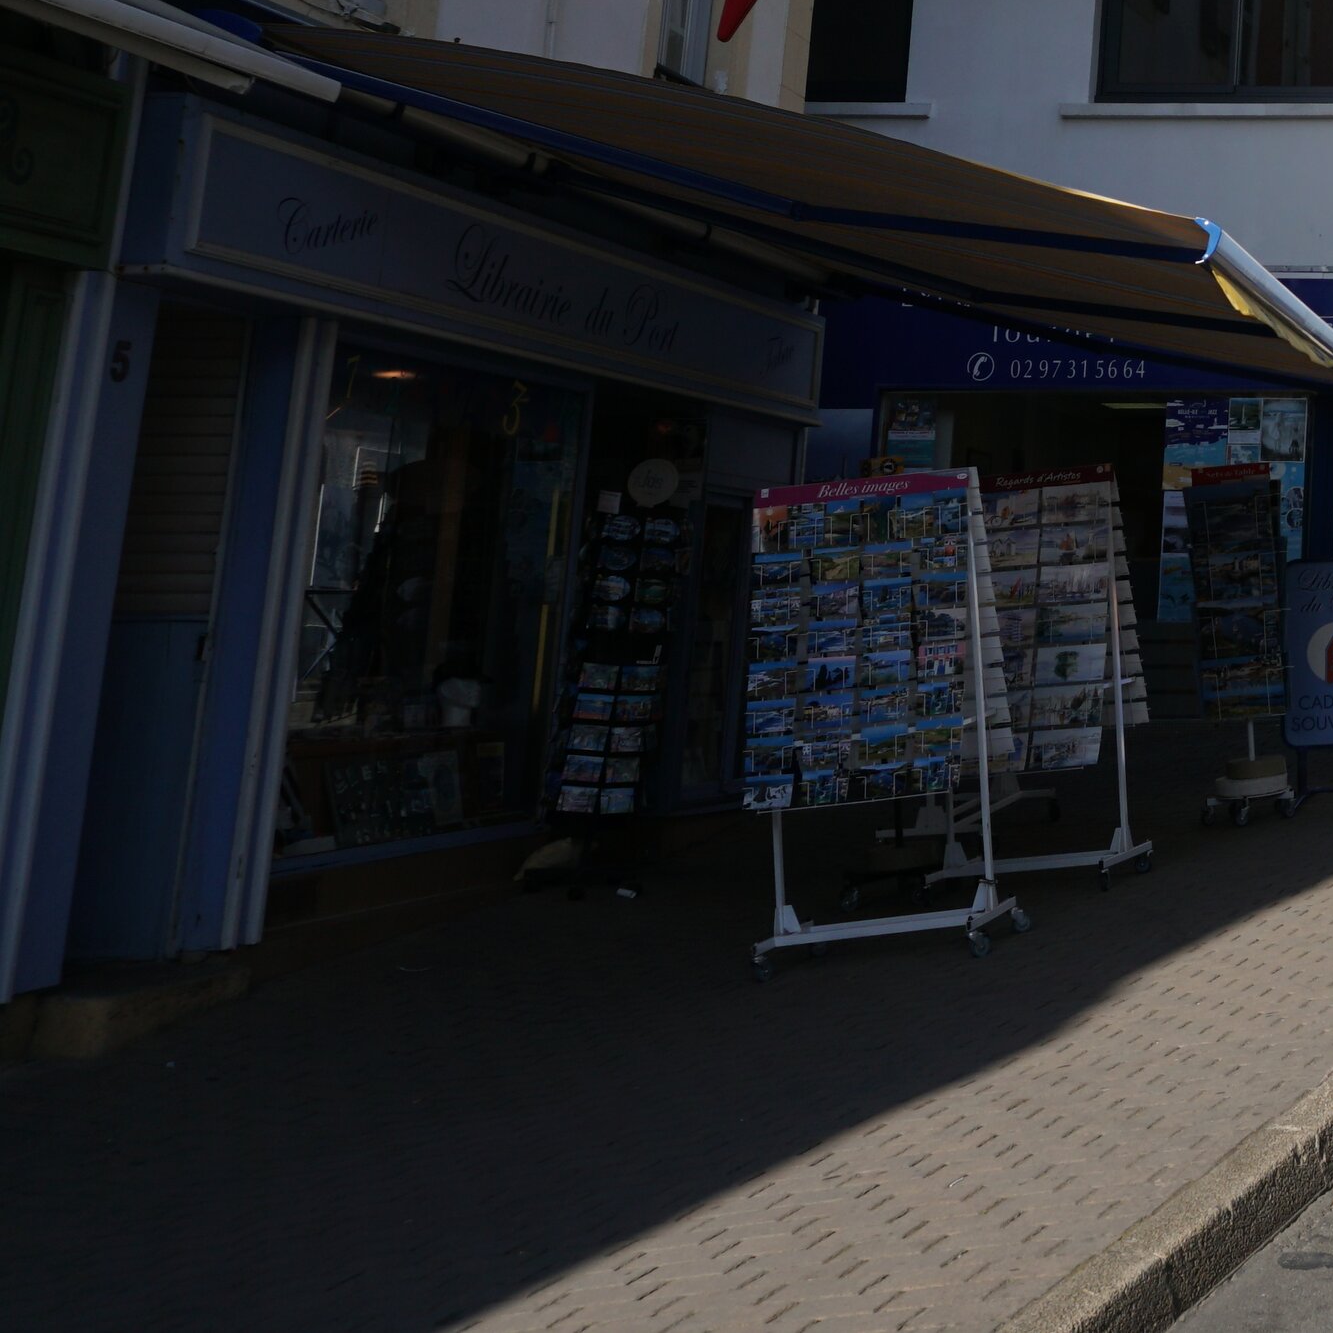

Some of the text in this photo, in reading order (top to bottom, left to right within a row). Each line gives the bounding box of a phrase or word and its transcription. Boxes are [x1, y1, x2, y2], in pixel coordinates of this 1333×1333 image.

[277, 196, 380, 254] Carterie
[447, 224, 680, 353] Librairie du Port
[111, 340, 132, 383] 5
[816, 479, 911, 499] Belles images
[995, 471, 1081, 489] Regards d'Artistes
[1300, 595, 1322, 612] du
